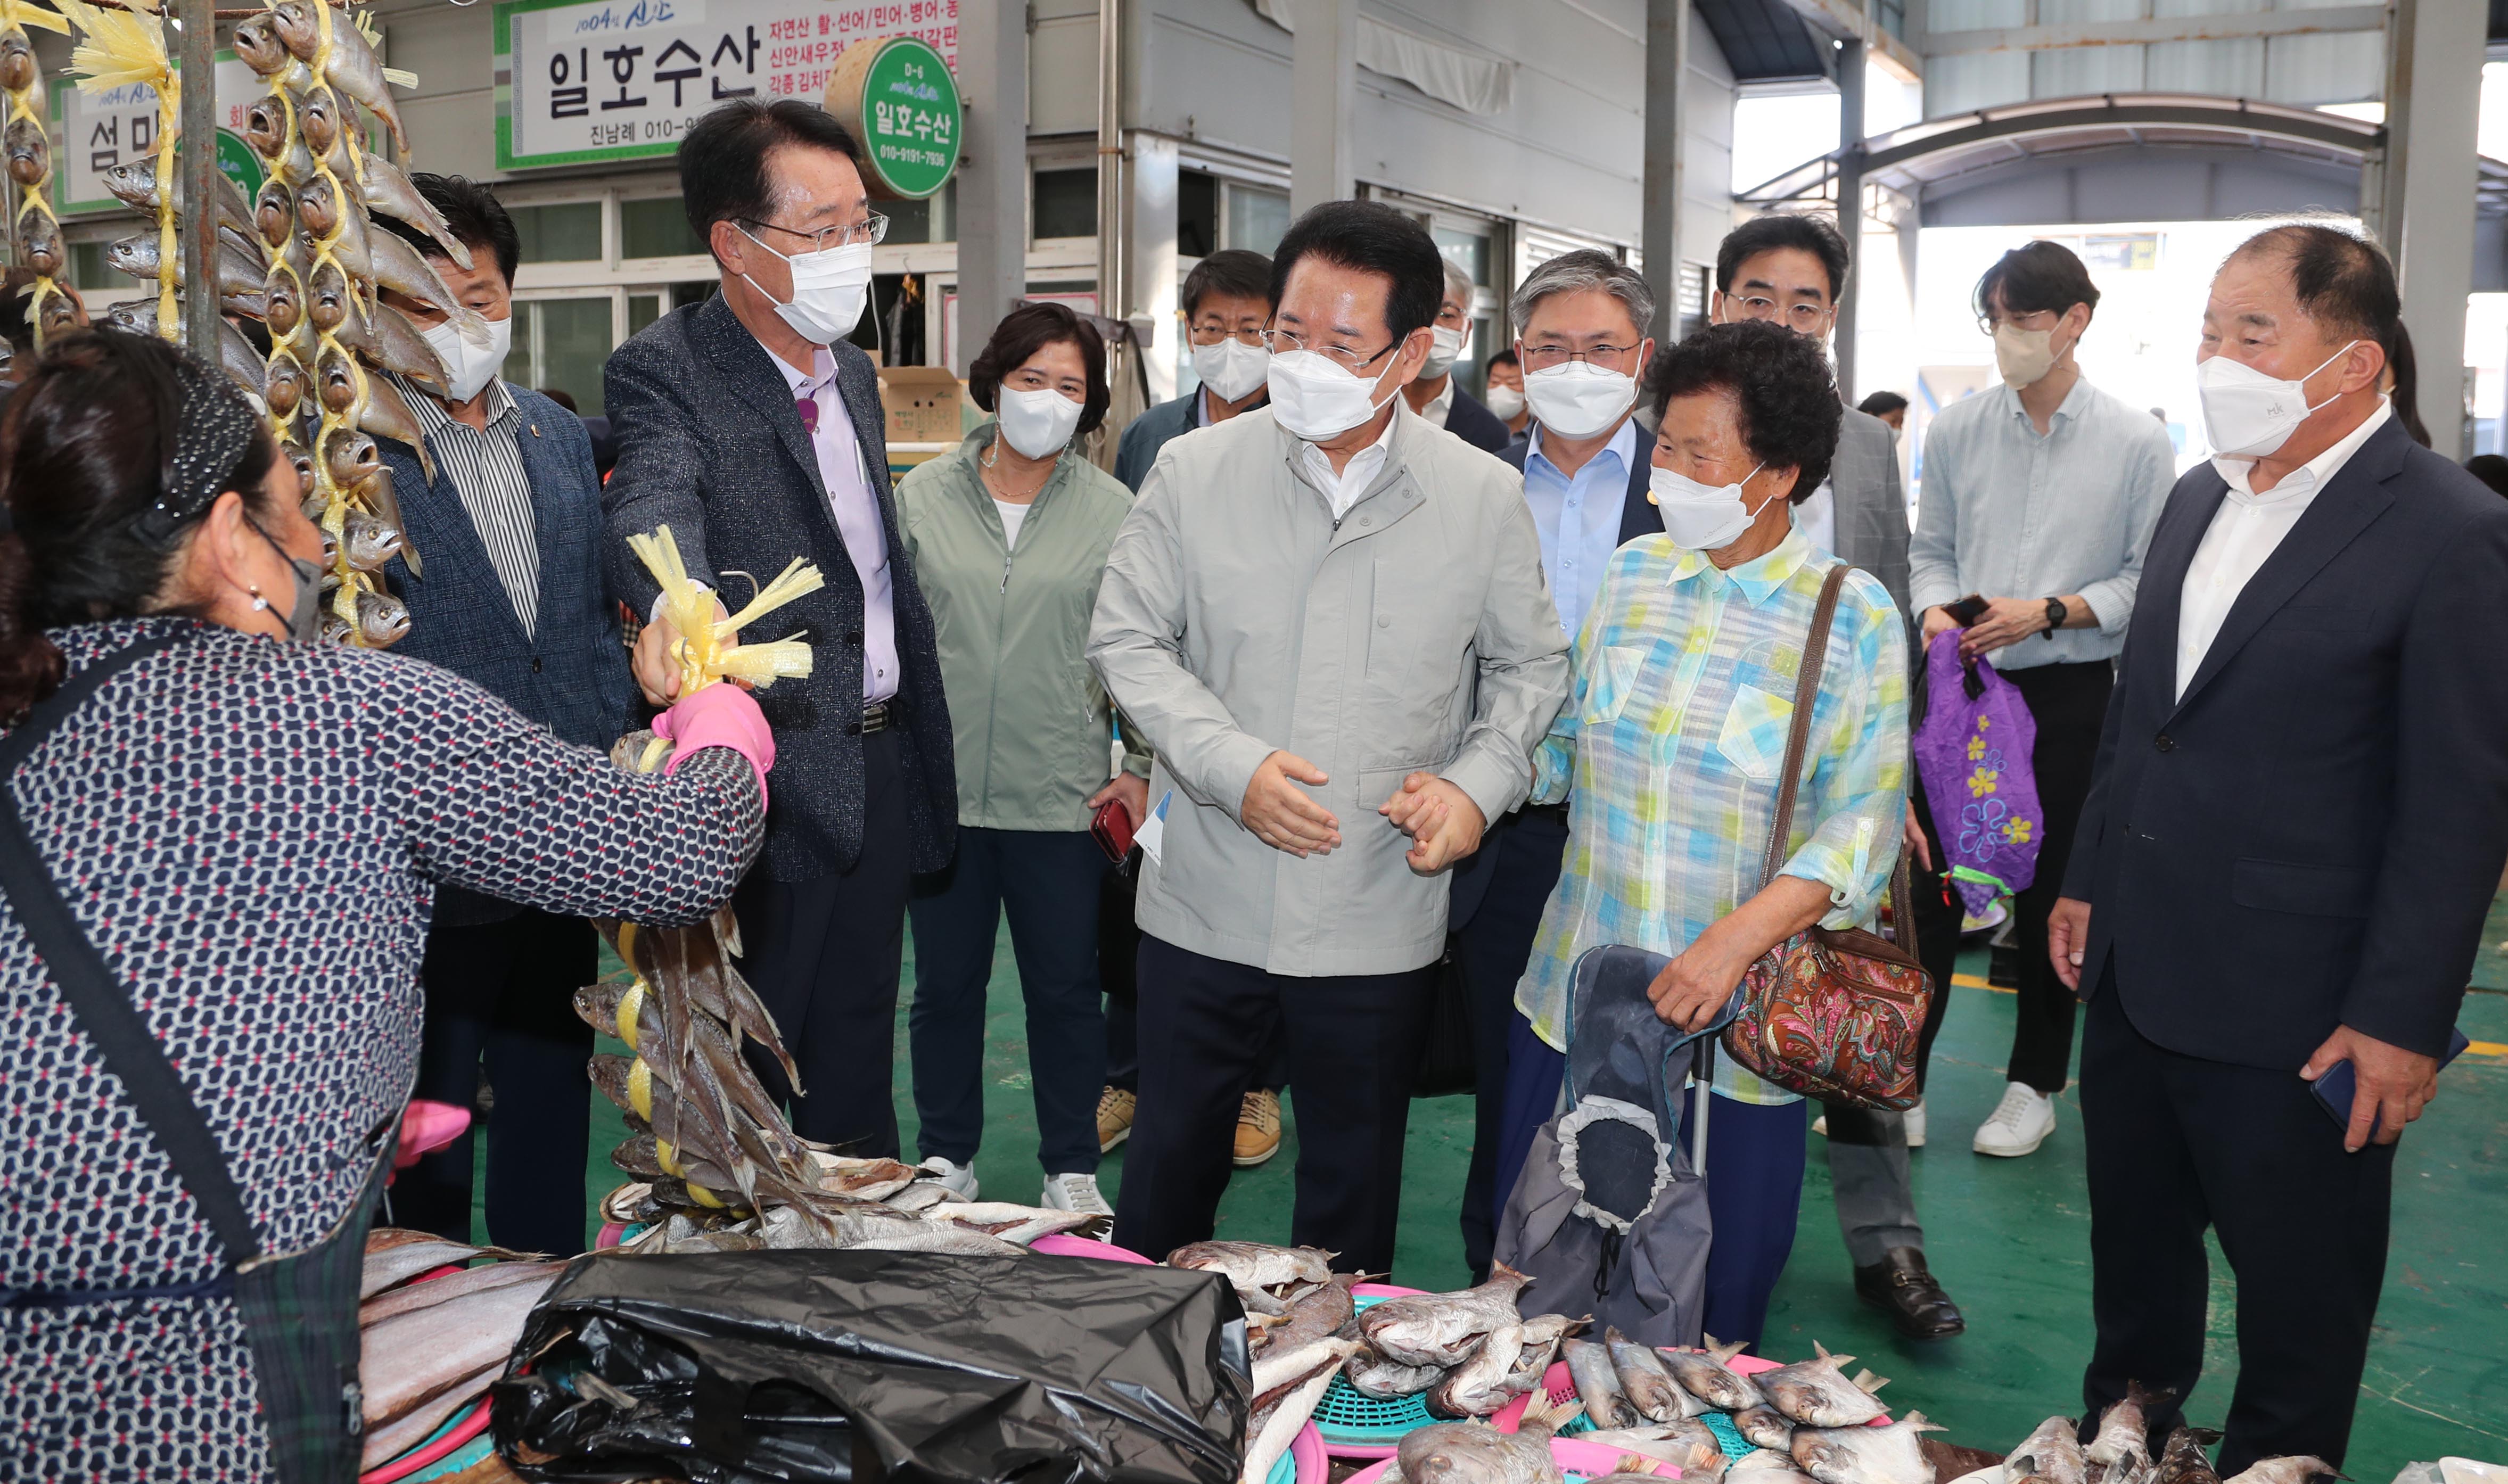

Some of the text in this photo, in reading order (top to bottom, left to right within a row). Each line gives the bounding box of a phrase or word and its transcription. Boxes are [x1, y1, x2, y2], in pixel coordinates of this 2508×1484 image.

[769, 18, 810, 41] 자연산
[550, 25, 761, 119] 일호수산
[904, 62, 924, 79] D-6
[590, 121, 635, 146] 진남례
[875, 100, 952, 145] 일호수산
